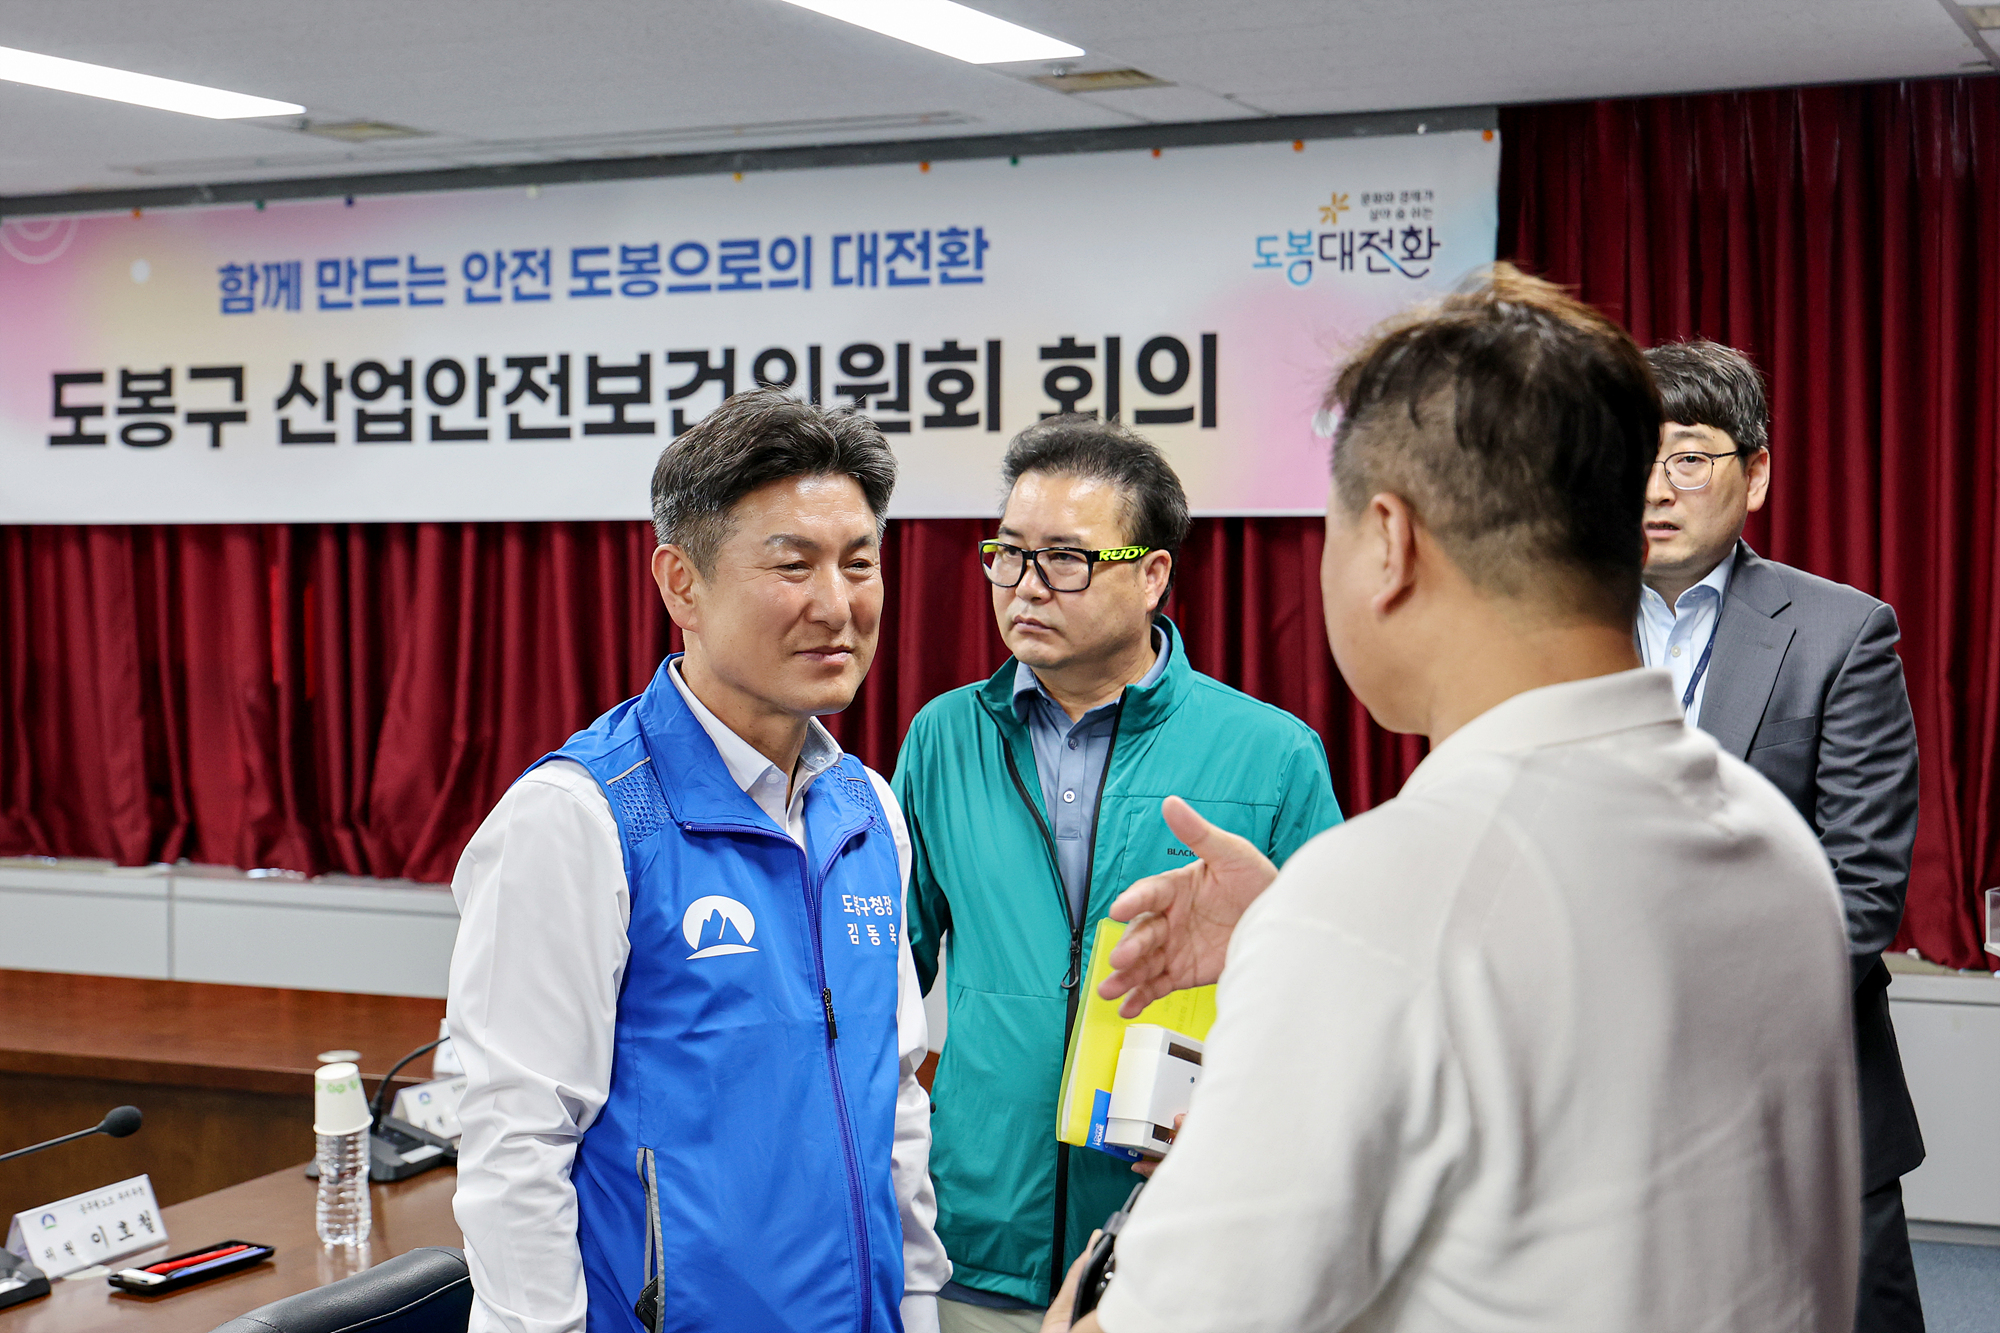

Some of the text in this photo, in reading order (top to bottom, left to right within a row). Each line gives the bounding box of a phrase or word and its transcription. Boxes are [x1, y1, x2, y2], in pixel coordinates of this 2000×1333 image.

[219, 227, 989, 315] 함께 만드는 안전 도봉으로의 대전환
[49, 365, 248, 448] 도봉구
[1039, 333, 1218, 428] 회의
[1099, 547, 1149, 561] RUDY
[1167, 848, 1199, 858] BLACK
[841, 894, 893, 917] 도봉구청장
